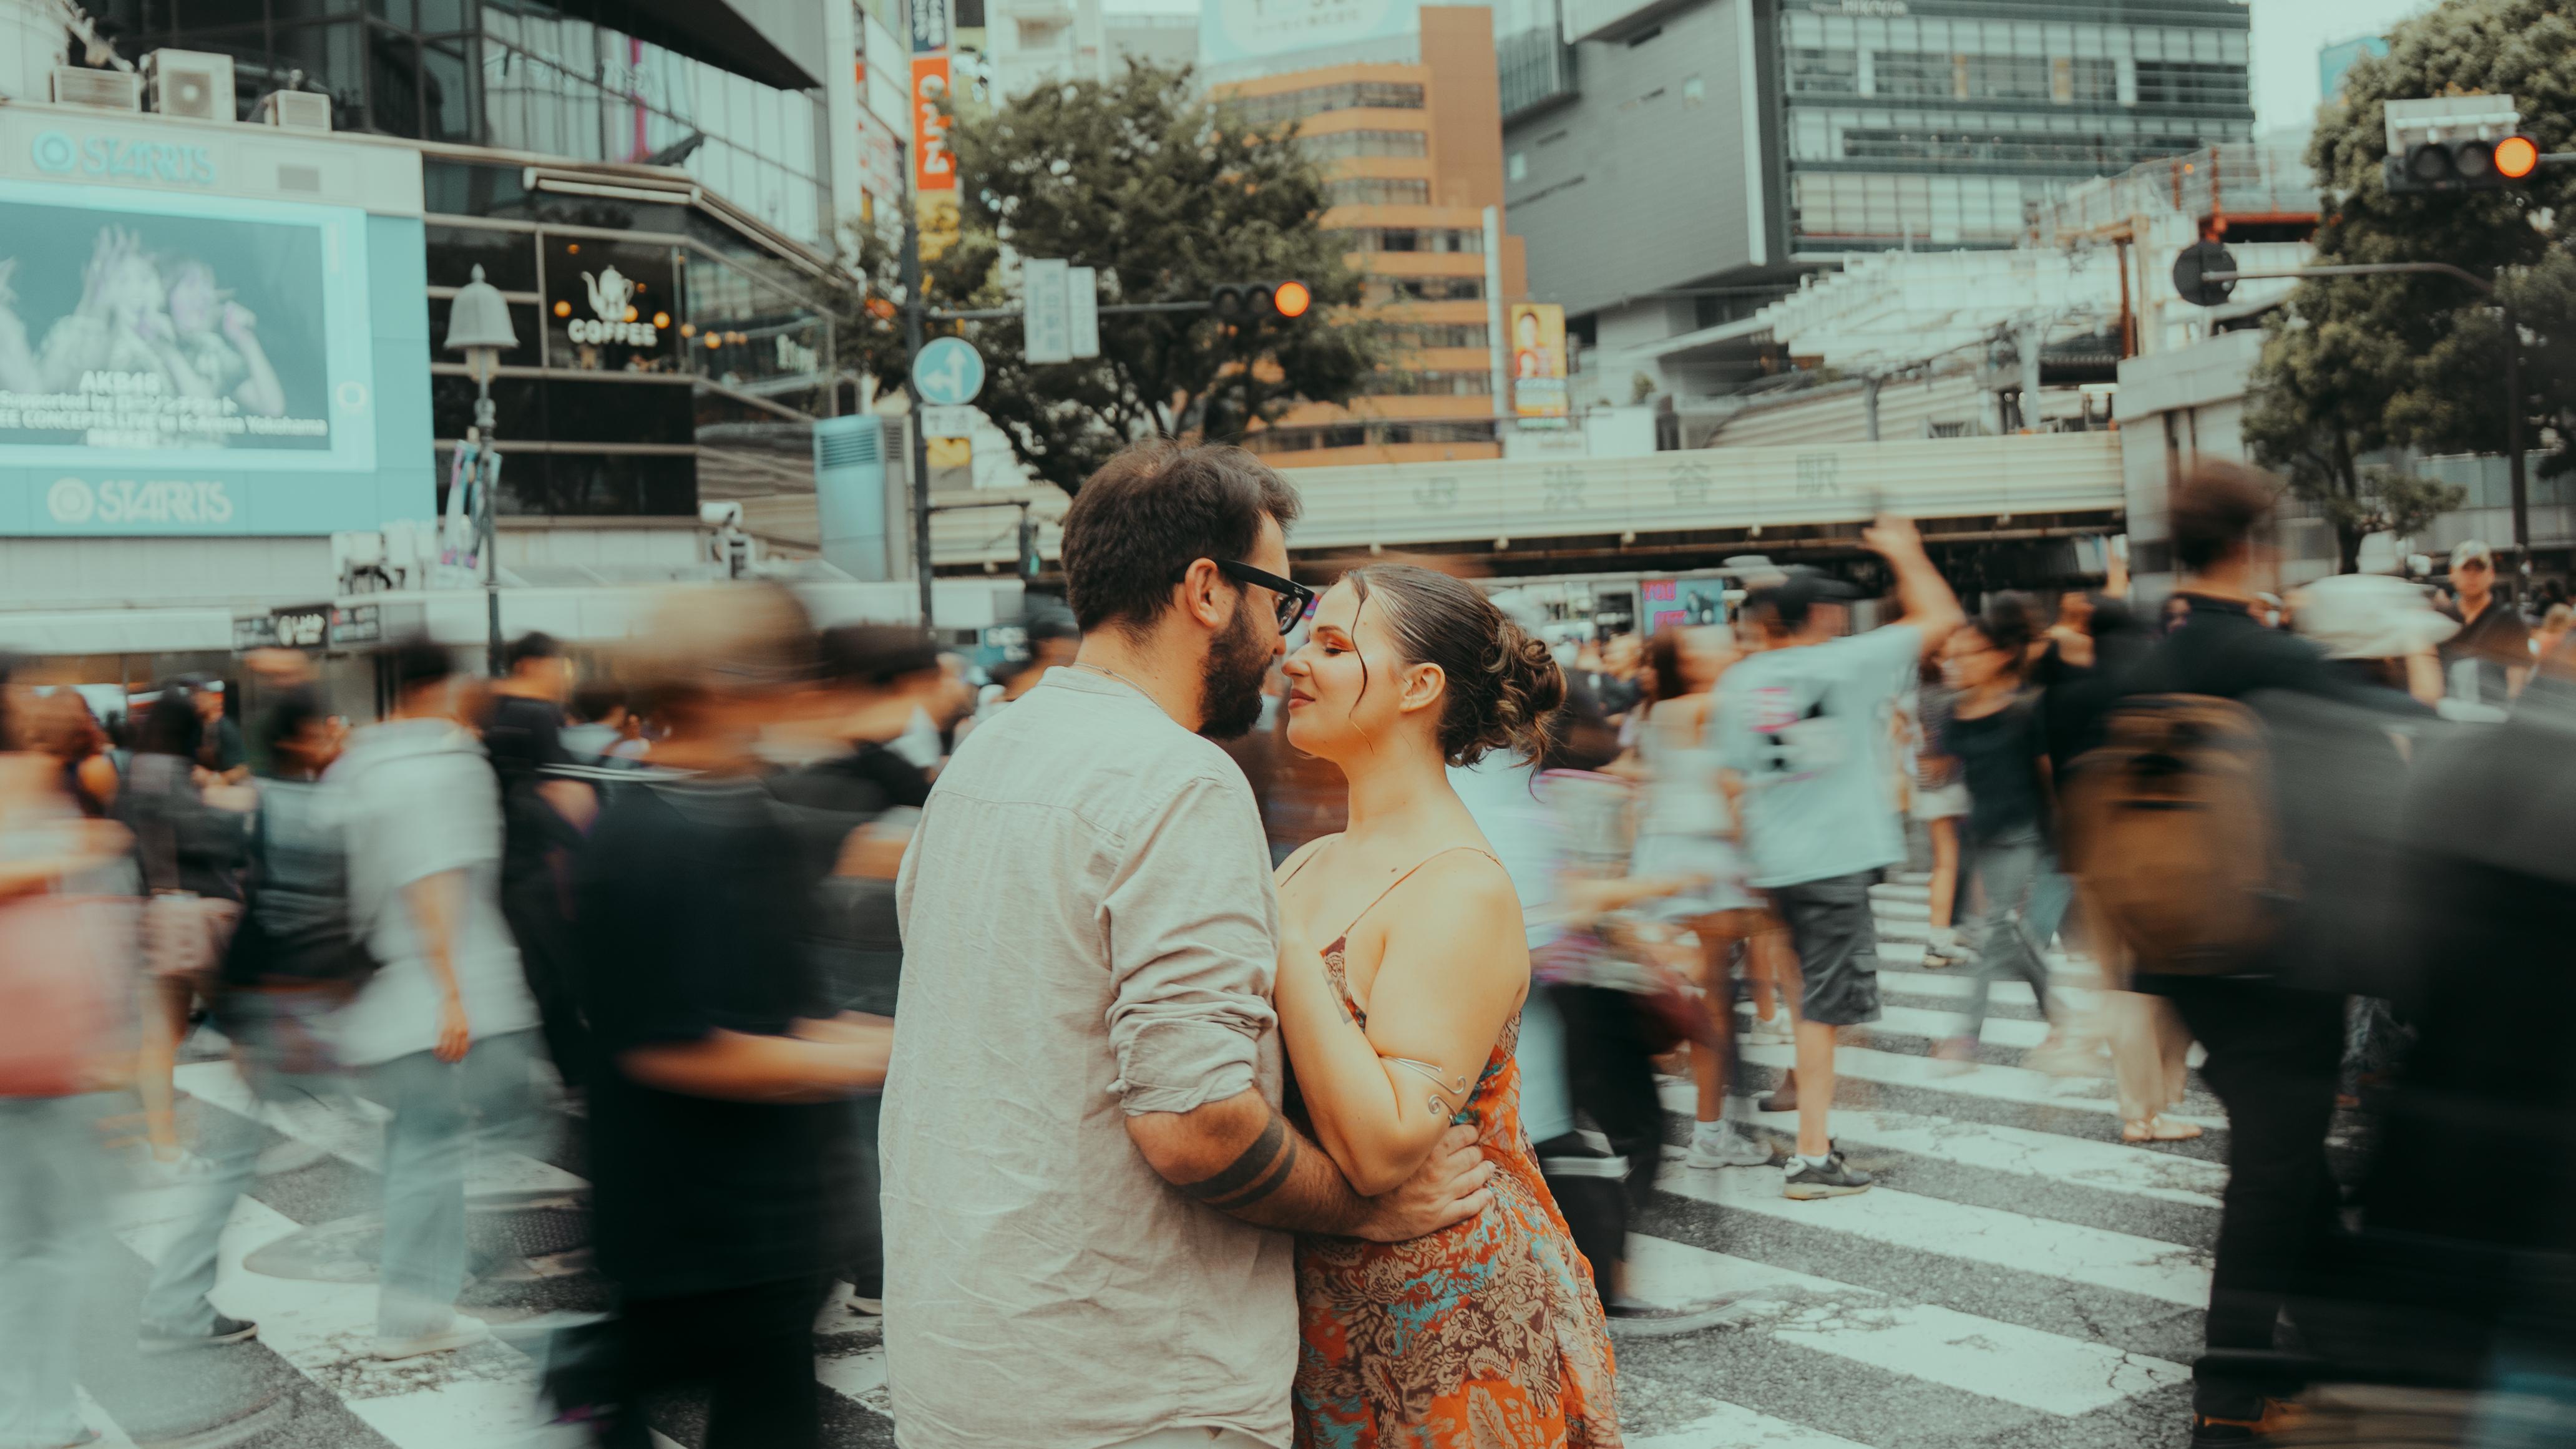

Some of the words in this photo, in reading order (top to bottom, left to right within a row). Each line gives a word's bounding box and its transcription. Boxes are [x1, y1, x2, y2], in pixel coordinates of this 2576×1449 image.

[82, 135, 215, 185] STARTS
[567, 318, 658, 348] COFFEE
[79, 370, 162, 395] AKB48
[22, 409, 116, 431] CONCEPTS
[246, 415, 328, 437] Yokohama
[98, 481, 232, 523] STARTS
